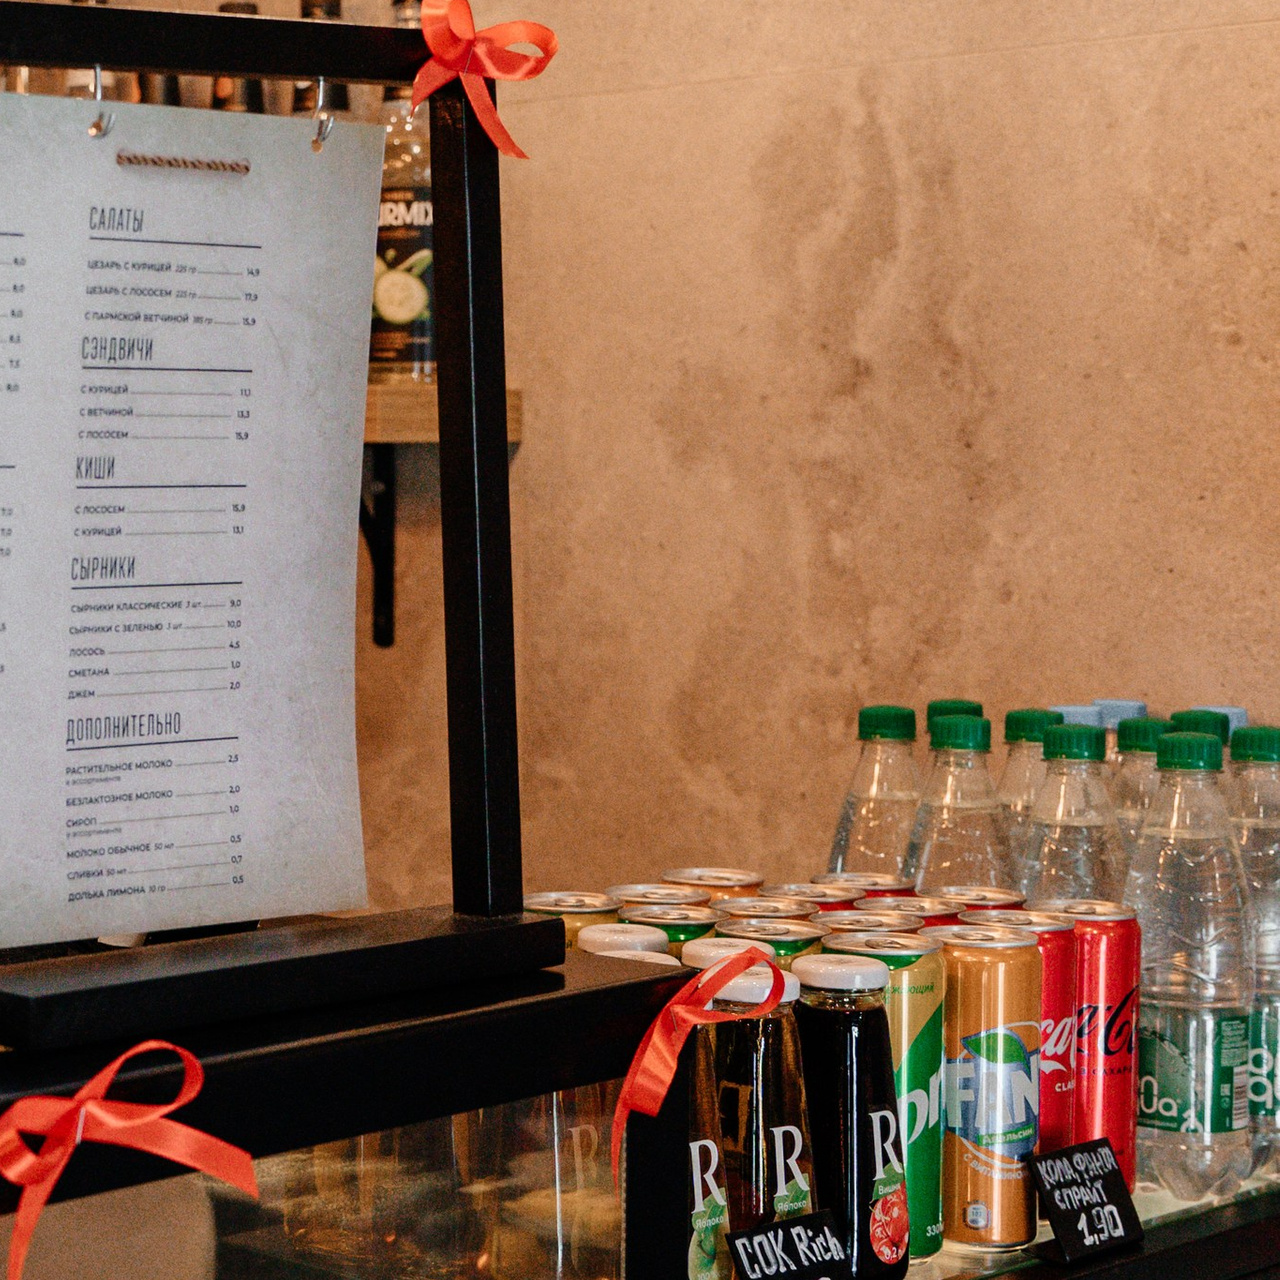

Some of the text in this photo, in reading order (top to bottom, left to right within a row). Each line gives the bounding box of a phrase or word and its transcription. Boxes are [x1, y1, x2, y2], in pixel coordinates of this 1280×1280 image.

[89, 206, 144, 232] САЛАТЫ
[87, 260, 121, 270] ЦЕЗАРЬ
[131, 262, 172, 272] КУРИЦЕЙ
[247, 268, 260, 276] 14,9
[86, 286, 120, 295] ЦЕЗАРЬ
[129, 287, 172, 297] ЛОСОСЕМ
[143, 314, 189, 323] ВЕТЧИНОЙ
[81, 336, 153, 362] СЭНДВИЧИ
[88, 385, 129, 395] КУРИЦЕЙ
[87, 407, 134, 417] ВЕТЧИНОЙ
[86, 430, 129, 439] ЛОСОСЕМ
[75, 457, 115, 479] КИШИ
[83, 505, 125, 514] ЛОСОСЕМ
[81, 527, 122, 537] КУРИЦЕЙ
[71, 556, 136, 581] СЫРНИКИ
[71, 604, 114, 613] СЫРНИКИ
[116, 601, 182, 610] КЛАССИЧЕСКИЕ
[230, 599, 241, 607] 9,0
[69, 626, 112, 635] СЫРНИКИ
[123, 623, 163, 632] ЗЕЛЕНЬЮ
[227, 620, 241, 628] 10,0
[69, 647, 105, 657] ЛОСОСЬ
[68, 668, 109, 678] СМЕТАНА
[68, 681, 241, 700] ДЖЕМ 2,0
[65, 712, 182, 746] ДОПОЛНИТЕЛЬНО
[65, 762, 132, 775] РАСТИТЕЛЬНОЕ
[135, 759, 173, 769] МОЛОКО
[66, 785, 240, 807] БЕЗЛАКТОЗНОЕ МОЛОКО 2,0
[66, 818, 96, 828] СИРОП
[66, 848, 104, 859] МОЛОКО
[108, 843, 150, 854] ОБЫЧНОЕ
[230, 834, 242, 843] 0,5
[67, 870, 103, 880] СЛИВКИ
[68, 891, 104, 903] ДОЛЬКА
[107, 887, 145, 897] ЛИМОНА
[232, 875, 244, 884] 0,5
[770, 1125, 810, 1198] R
[689, 1139, 727, 1215] R
